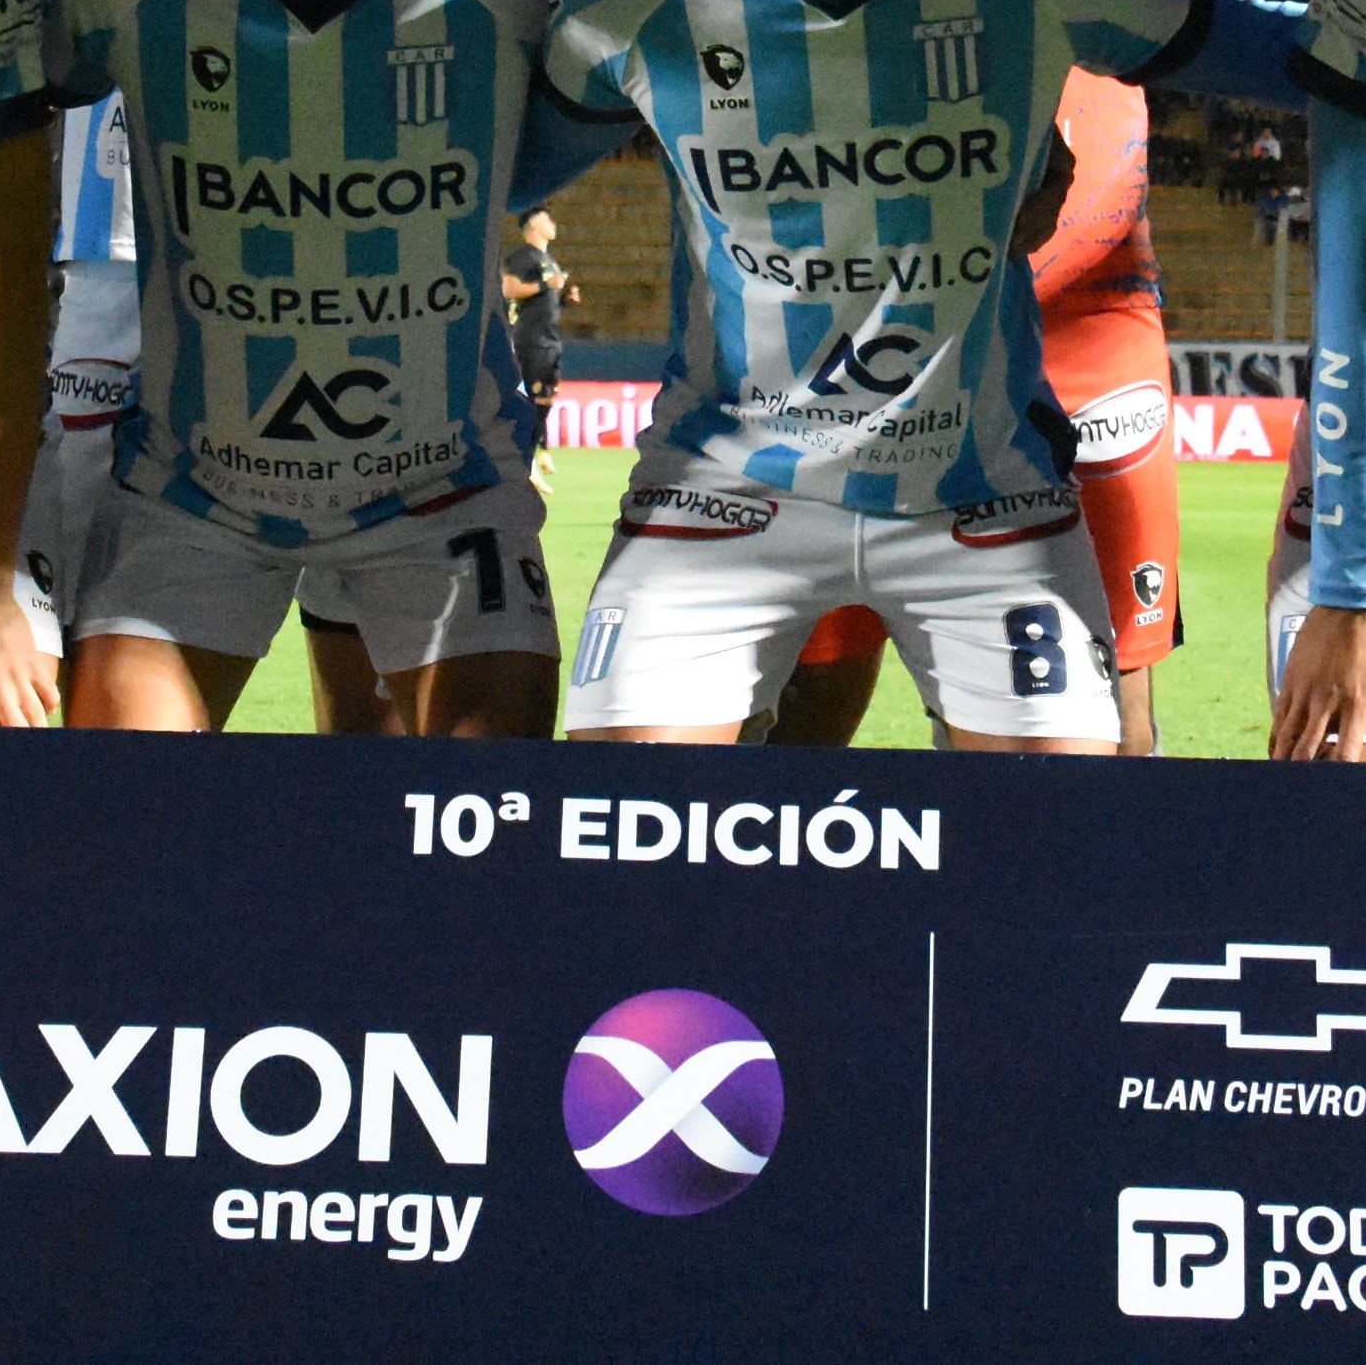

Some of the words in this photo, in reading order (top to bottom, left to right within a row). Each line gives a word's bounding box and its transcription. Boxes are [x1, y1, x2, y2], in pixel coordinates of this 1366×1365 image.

[192, 98, 231, 113] LYON
[709, 98, 750, 111] LYON
[196, 160, 466, 220] BANCOR
[717, 128, 999, 193] BANCOR
[258, 368, 393, 442] AC
[199, 435, 341, 481] Adhemar
[352, 433, 460, 478] Capital
[1316, 348, 1351, 527] LYON
[31, 597, 56, 614] LYON
[1136, 611, 1163, 626] LYON
[1002, 599, 1069, 699] 8
[558, 786, 943, 872] EDICIÓN
[1118, 1077, 1215, 1113] PLAN
[211, 1187, 485, 1262] energy
